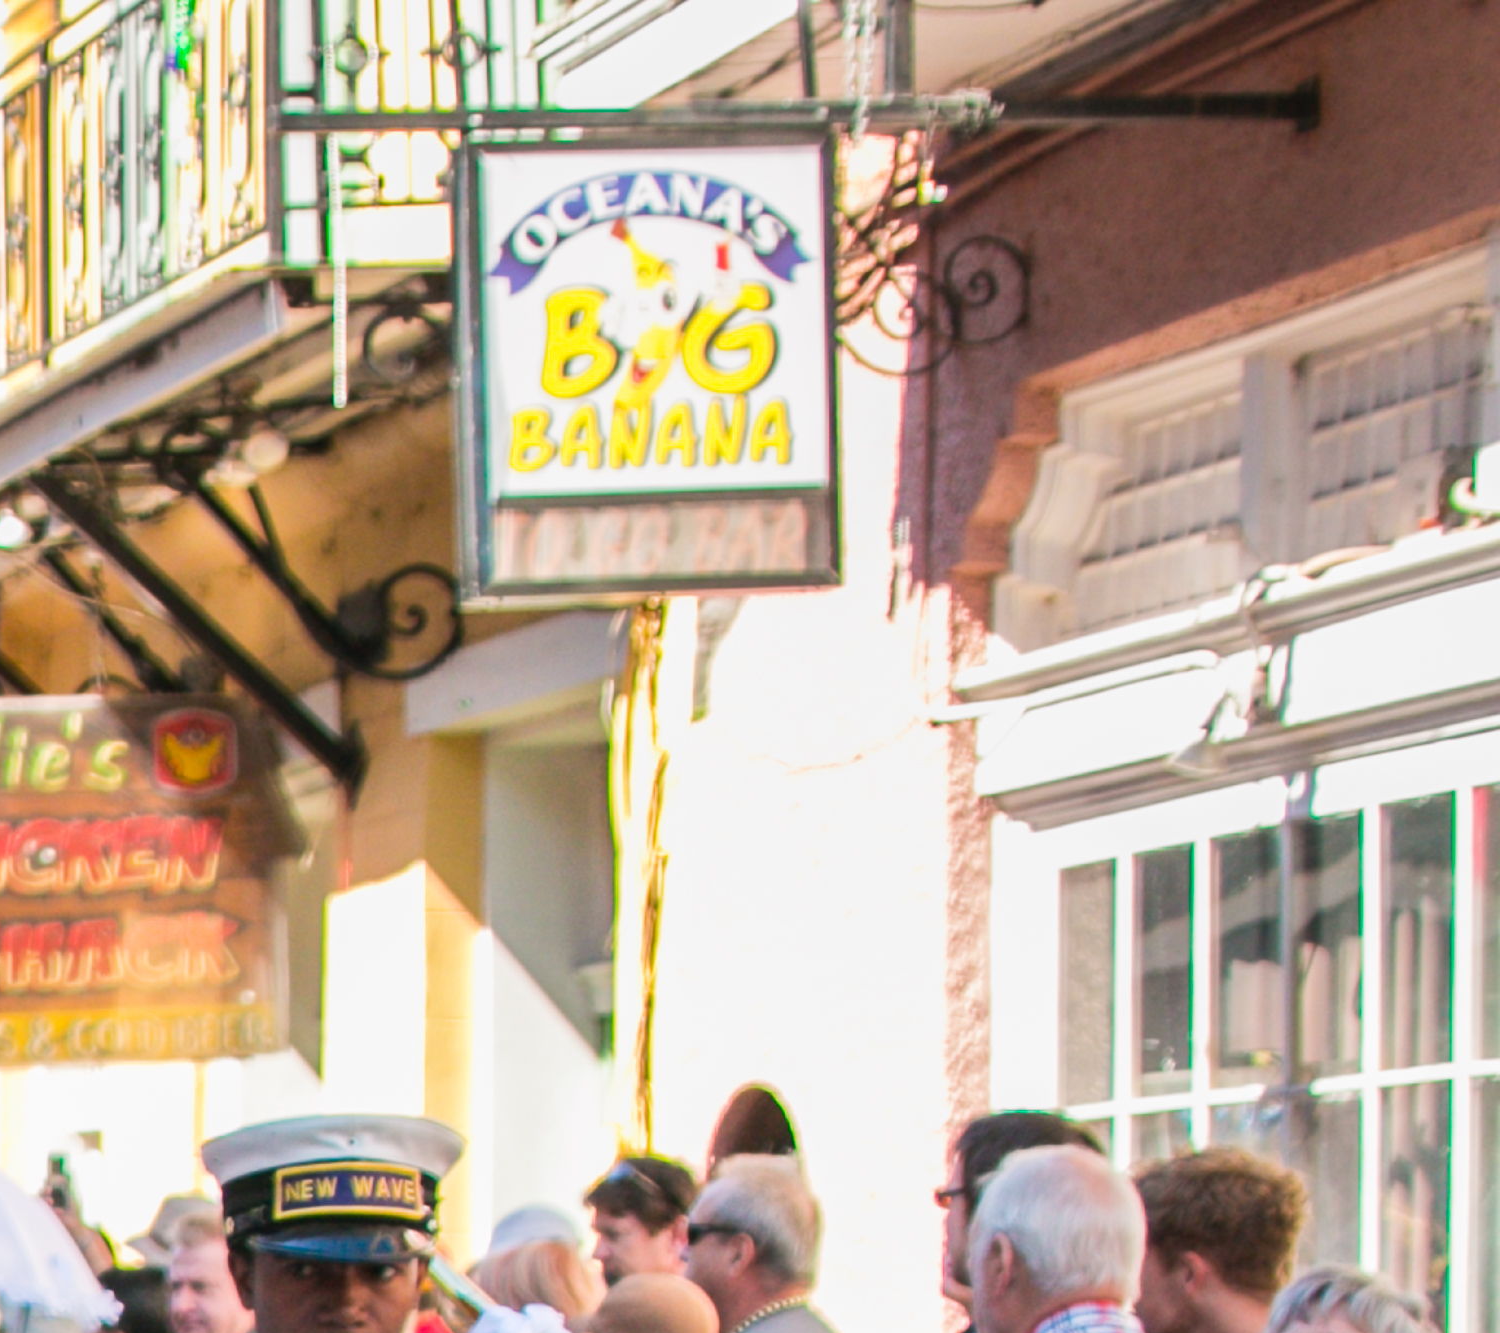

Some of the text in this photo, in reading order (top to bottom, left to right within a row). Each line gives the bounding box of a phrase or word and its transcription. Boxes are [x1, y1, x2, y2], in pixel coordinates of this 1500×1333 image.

[512, 171, 787, 263] OCEANA'S
[508, 395, 792, 473] BANANA
[284, 1174, 418, 1202] NEW WAVE
